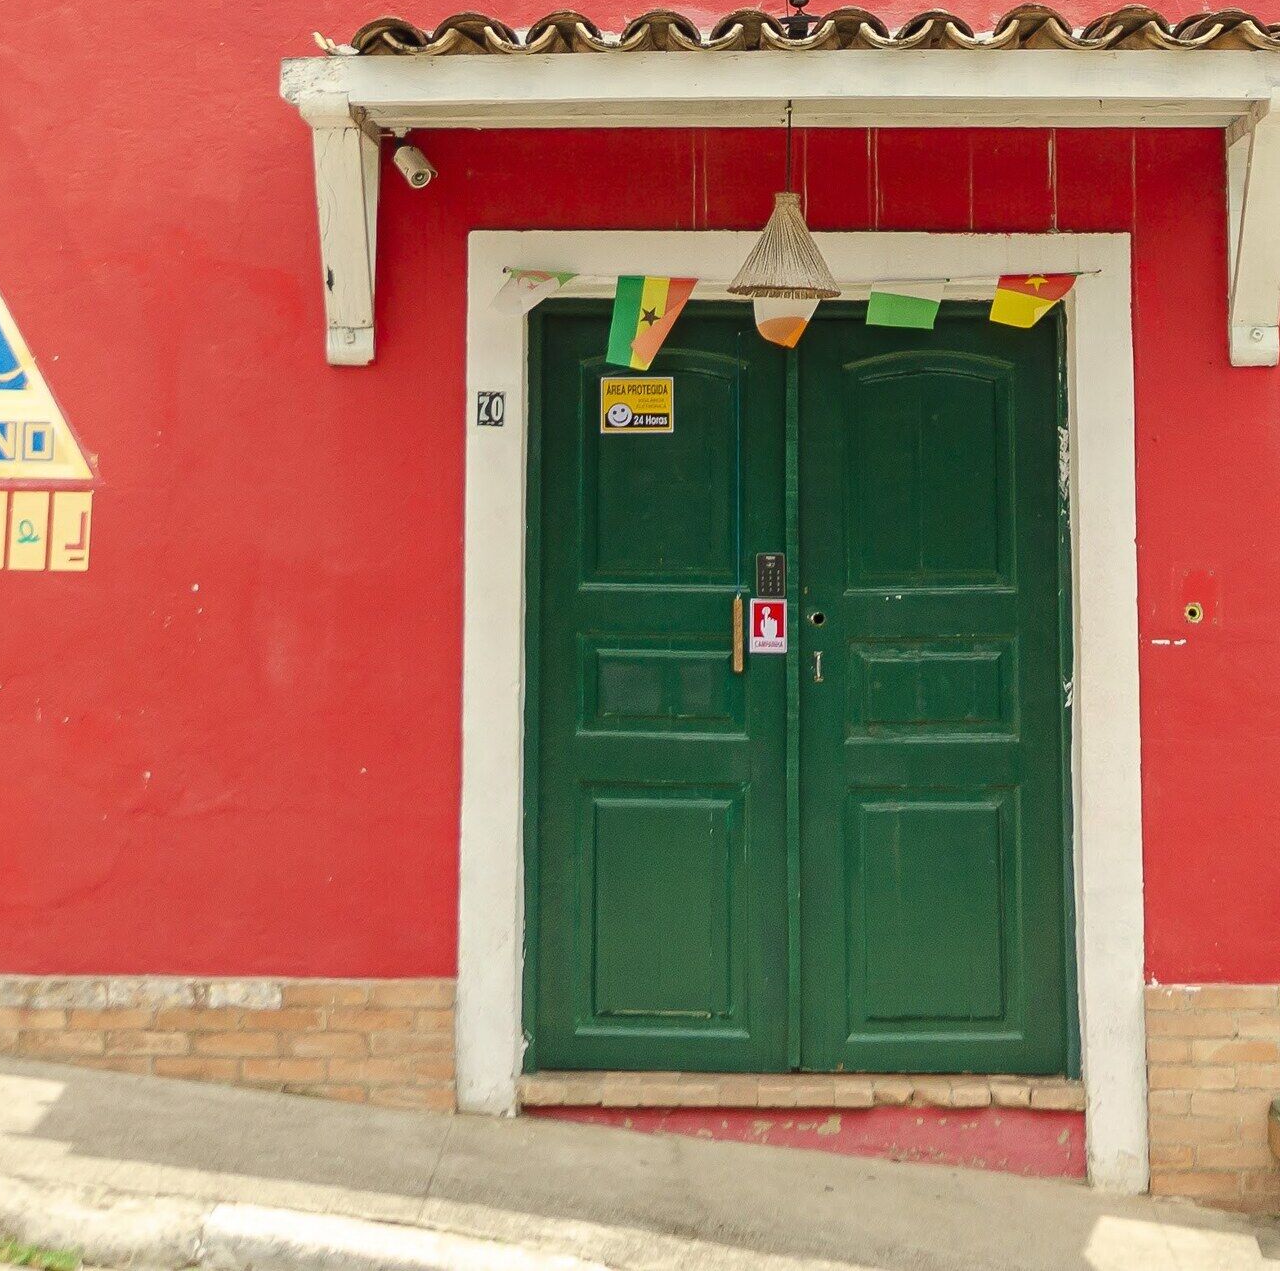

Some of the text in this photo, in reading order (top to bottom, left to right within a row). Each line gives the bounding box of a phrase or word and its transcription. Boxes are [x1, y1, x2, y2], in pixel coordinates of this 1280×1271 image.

[606, 383, 626, 395] ÁREA
[633, 415, 668, 426] 24 Horas
